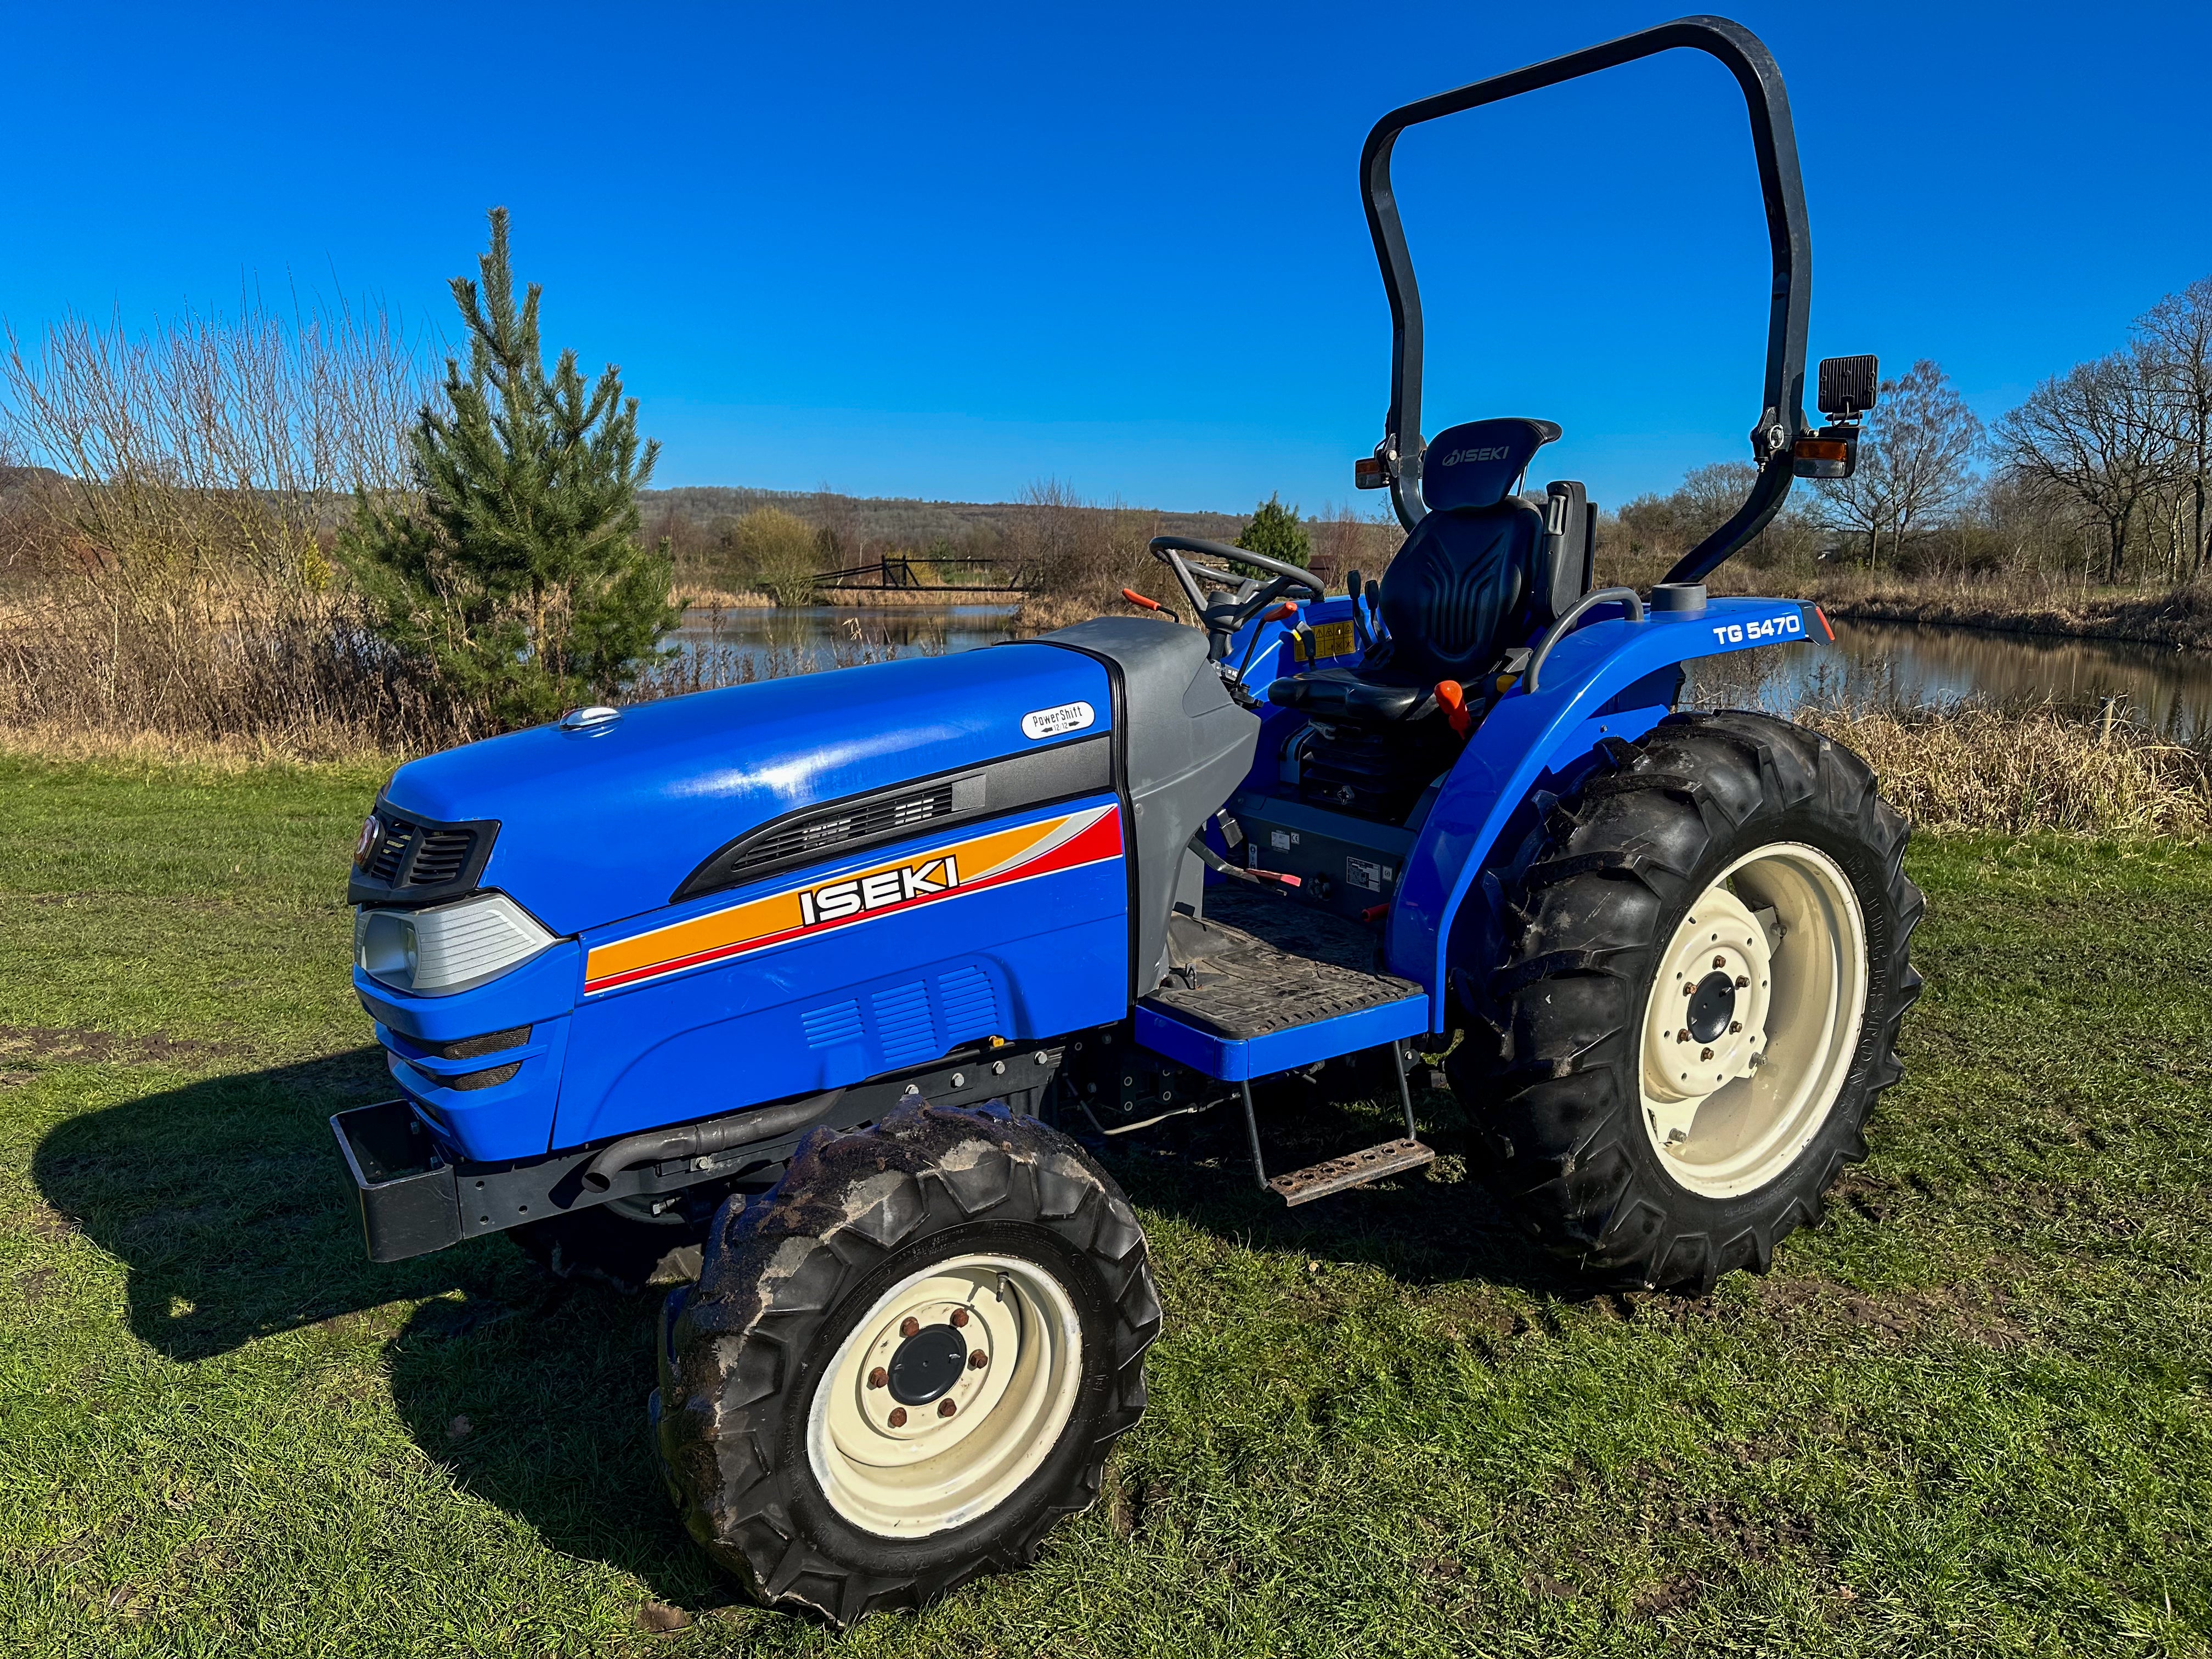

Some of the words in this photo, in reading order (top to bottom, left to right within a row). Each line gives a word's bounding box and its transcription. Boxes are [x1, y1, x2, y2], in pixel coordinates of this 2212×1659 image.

[1460, 446, 1509, 462] ISEKI
[1713, 624, 1743, 645] TG
[1746, 615, 1800, 639] 5470
[1032, 706, 1082, 727] PowerShift
[1054, 722, 1069, 731] 12/12
[799, 855, 958, 926] ISEKI
[1839, 851, 1888, 1124] BRIDGESTONE
[812, 1487, 1048, 1572] BRIDGESTONE
